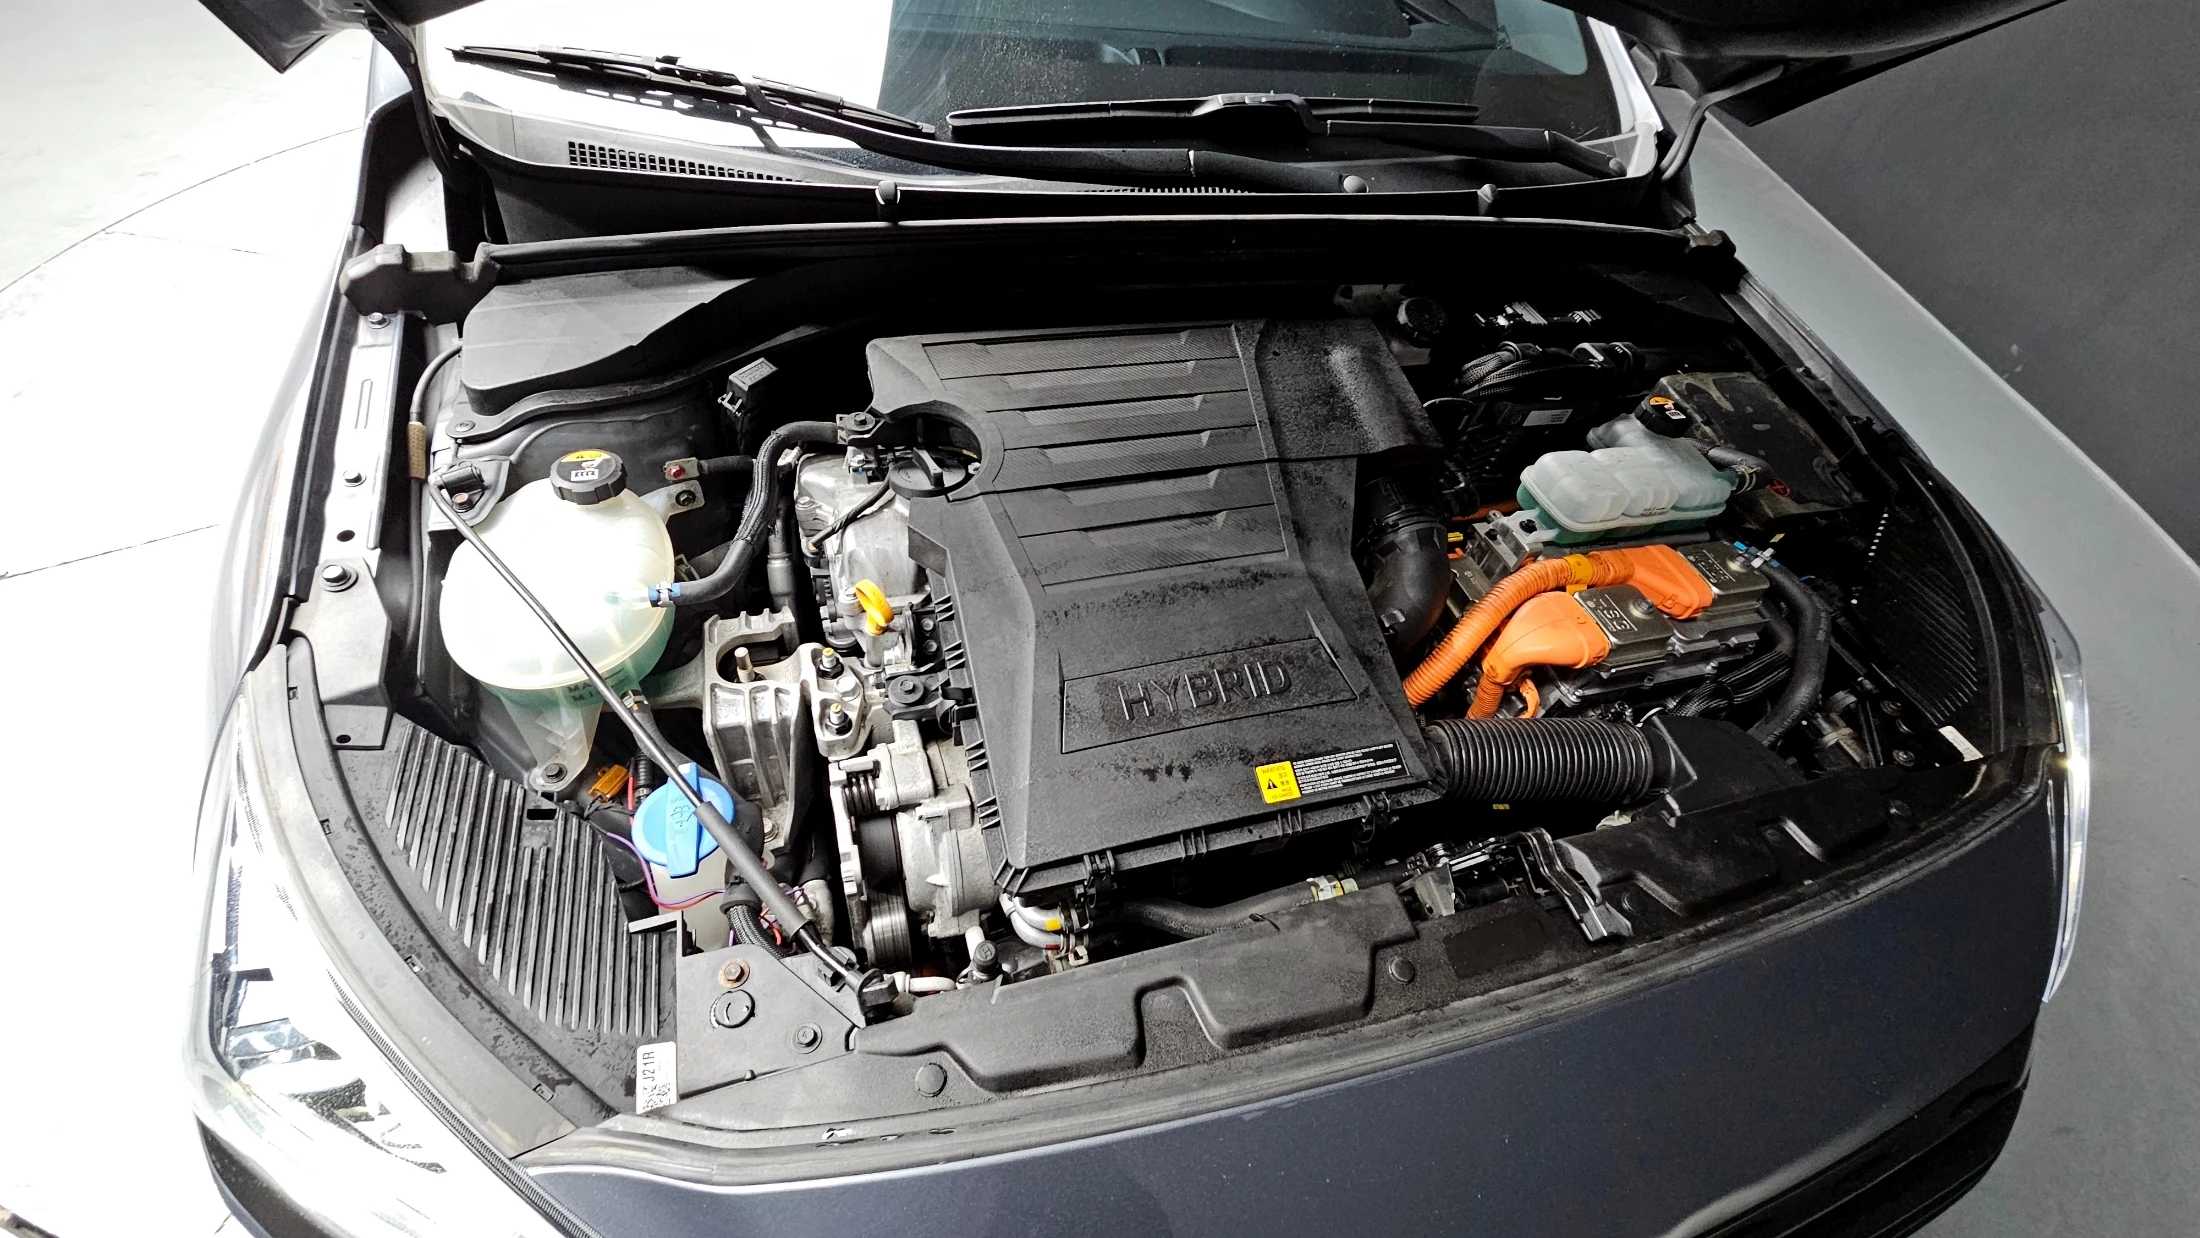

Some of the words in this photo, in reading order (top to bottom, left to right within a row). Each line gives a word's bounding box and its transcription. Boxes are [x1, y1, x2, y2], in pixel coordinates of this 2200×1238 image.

[567, 682, 591, 693] MA
[1117, 661, 1292, 721] HYBRID
[1261, 765, 1286, 774] WARNING
[642, 1051, 655, 1082] J21R
